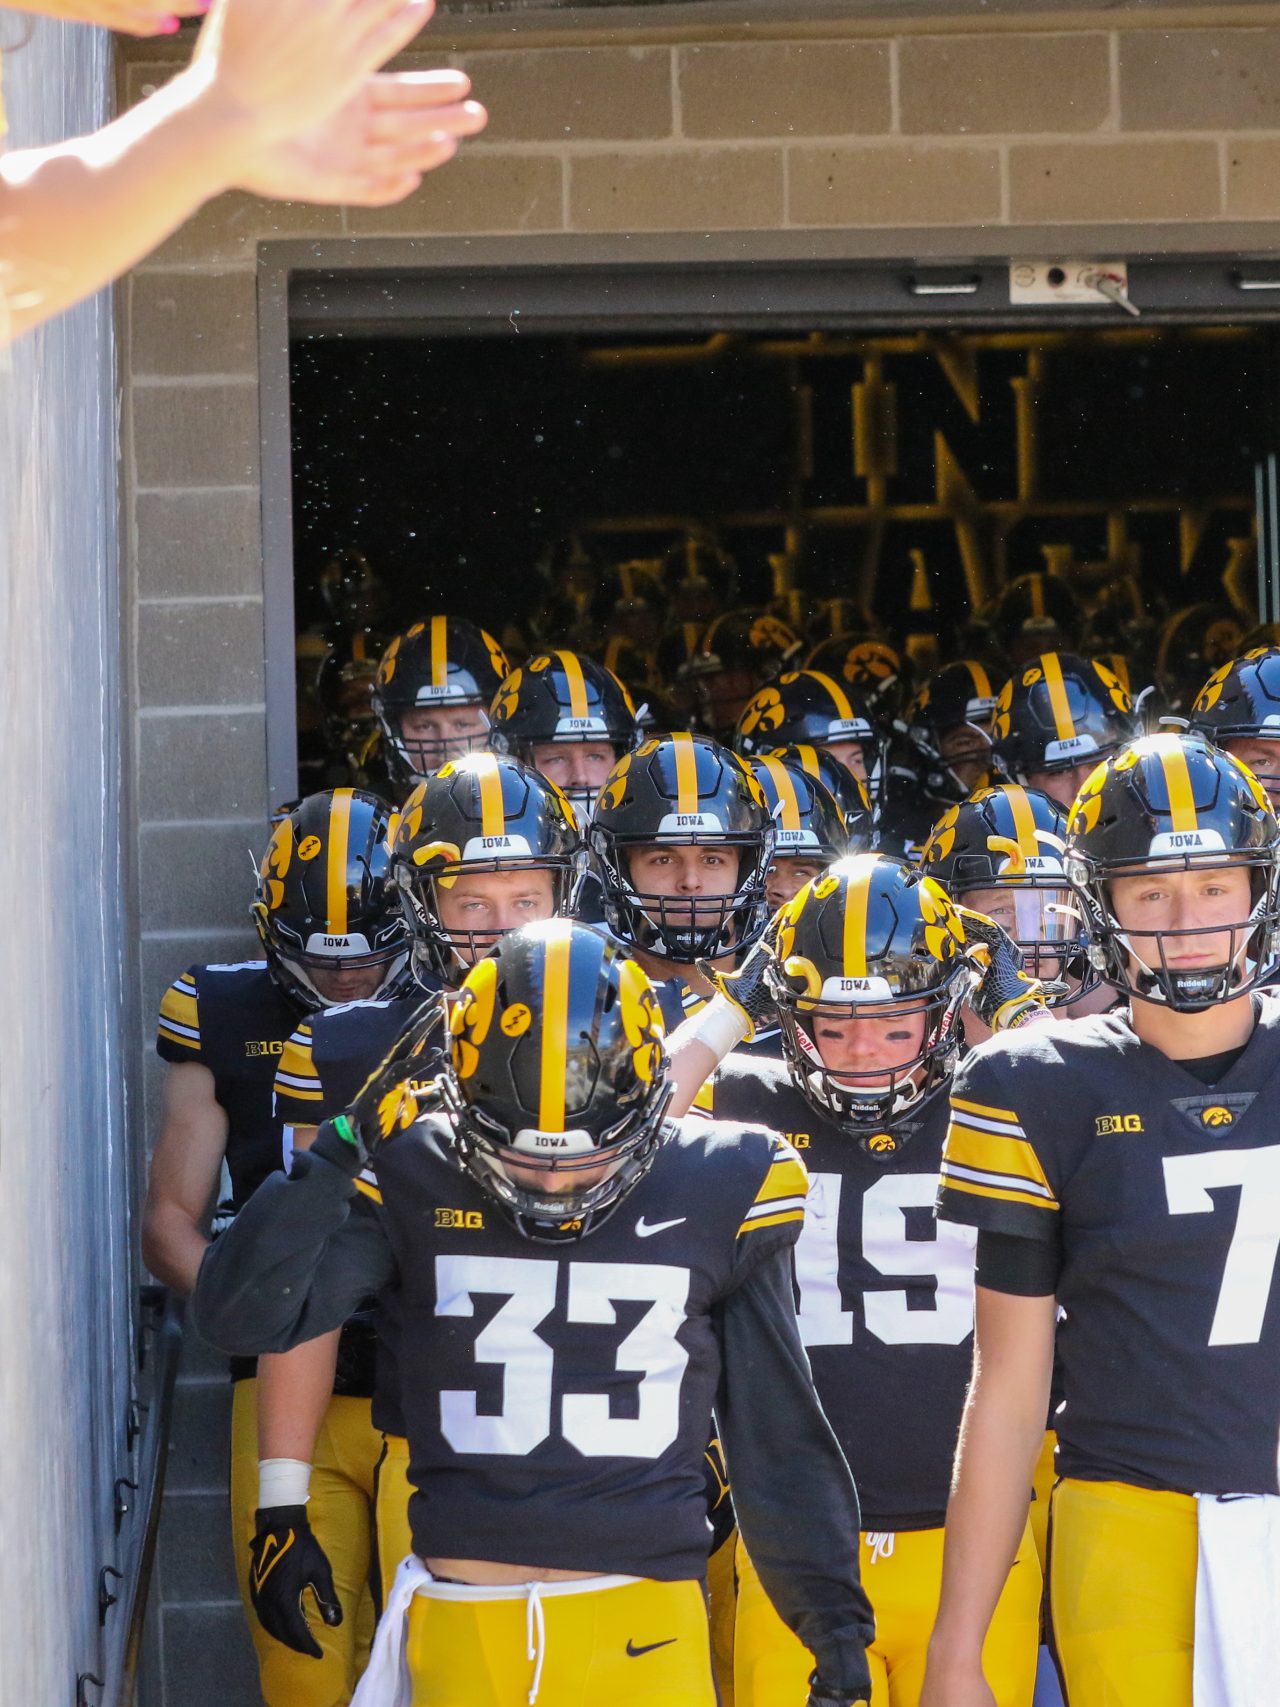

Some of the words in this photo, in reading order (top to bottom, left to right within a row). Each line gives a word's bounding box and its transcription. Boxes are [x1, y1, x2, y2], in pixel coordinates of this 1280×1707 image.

[430, 687, 451, 696] IOWA
[570, 720, 592, 729] IOWA
[840, 720, 860, 729] IOWA
[1059, 739, 1082, 750] IOWA
[677, 816, 705, 827] IOWA
[780, 832, 806, 842] IOWA
[1170, 834, 1203, 847] IOWA
[482, 837, 511, 849] IOWA
[324, 937, 350, 948] IOWA
[841, 980, 871, 991] IOWA
[535, 1136, 568, 1149] IOWA
[792, 1172, 978, 1346] 19
[434, 1255, 691, 1459] 33
